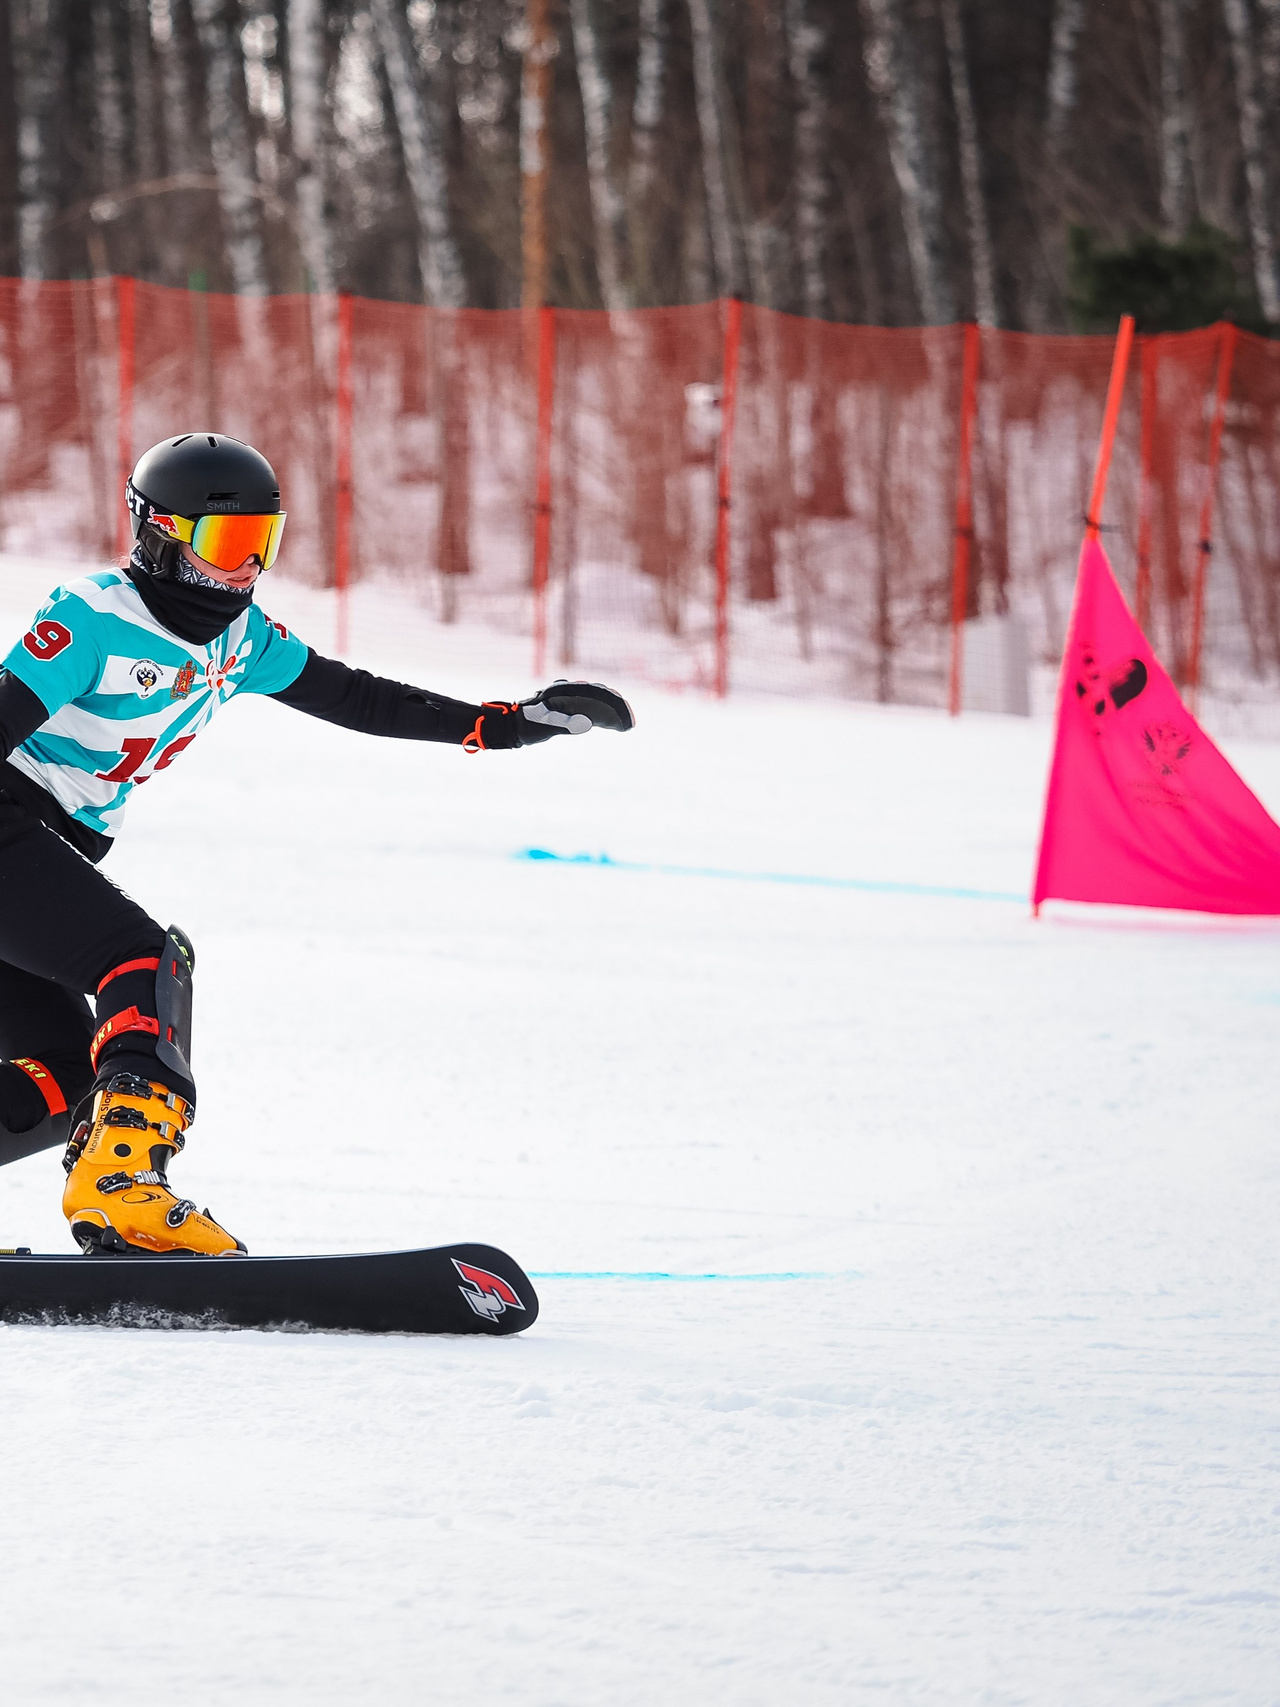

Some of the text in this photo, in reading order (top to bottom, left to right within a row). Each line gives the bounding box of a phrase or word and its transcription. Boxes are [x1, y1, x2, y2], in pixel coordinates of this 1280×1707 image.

[206, 502, 240, 511] SMITH
[22, 619, 73, 661] 9
[100, 1091, 115, 1113] Slop
